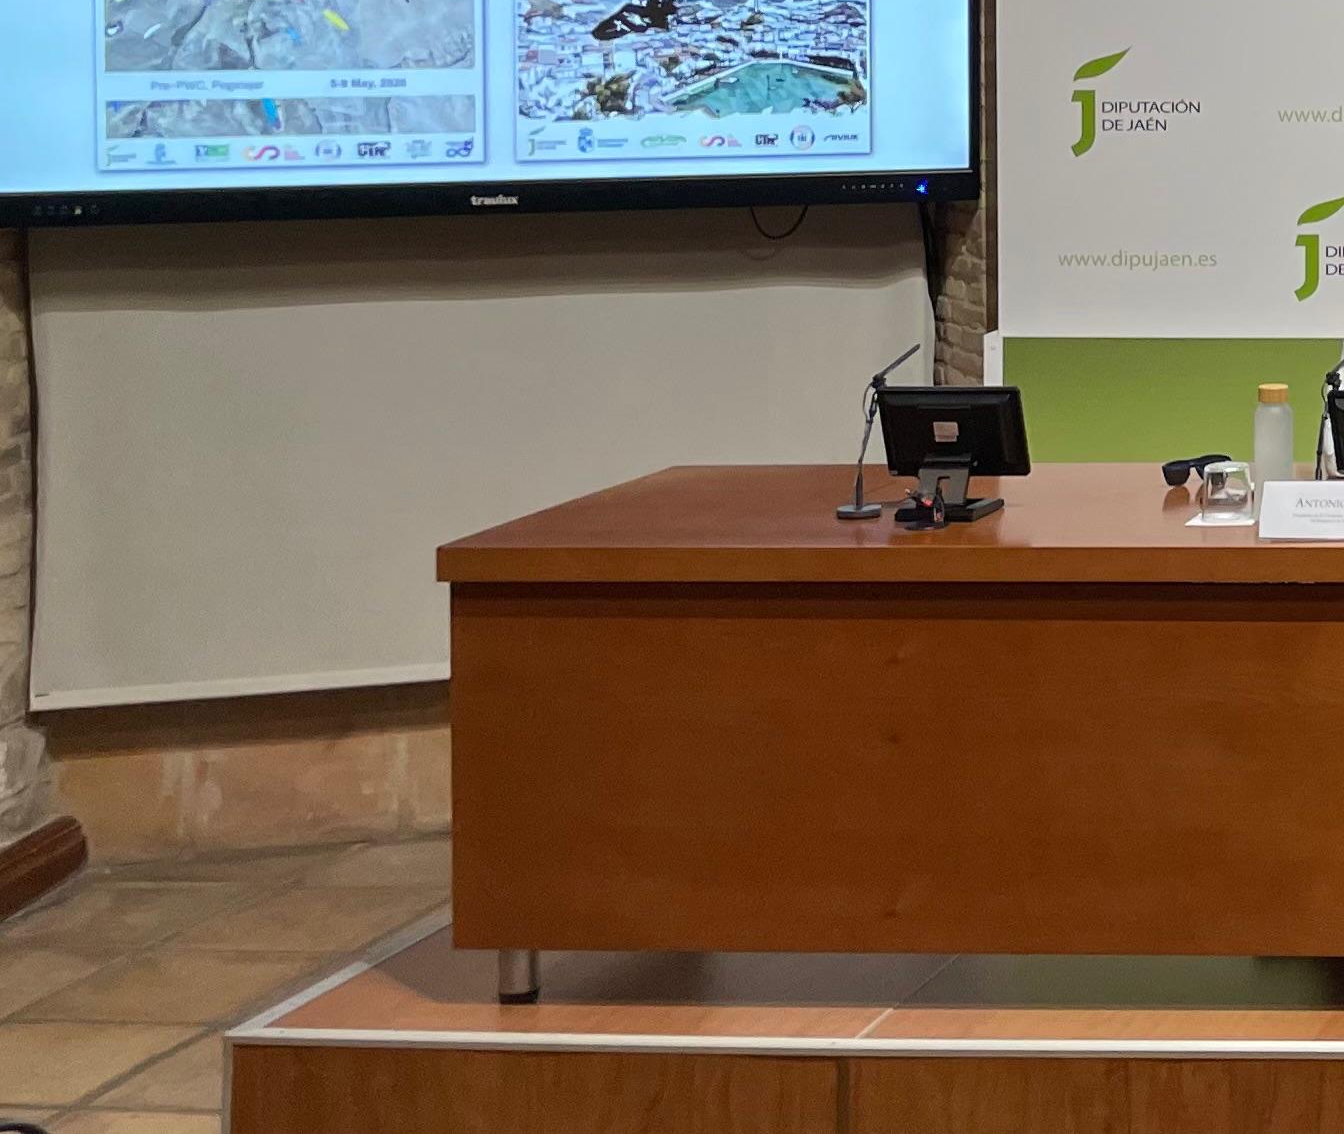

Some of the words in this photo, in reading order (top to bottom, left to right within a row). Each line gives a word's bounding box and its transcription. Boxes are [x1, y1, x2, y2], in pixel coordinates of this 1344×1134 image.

[1102, 99, 1200, 113] DIPUTACIÓN
[1102, 120, 1122, 131] DE
[1127, 117, 1166, 131] JAÉN
[1058, 249, 1217, 271] www.dipujaen.es
